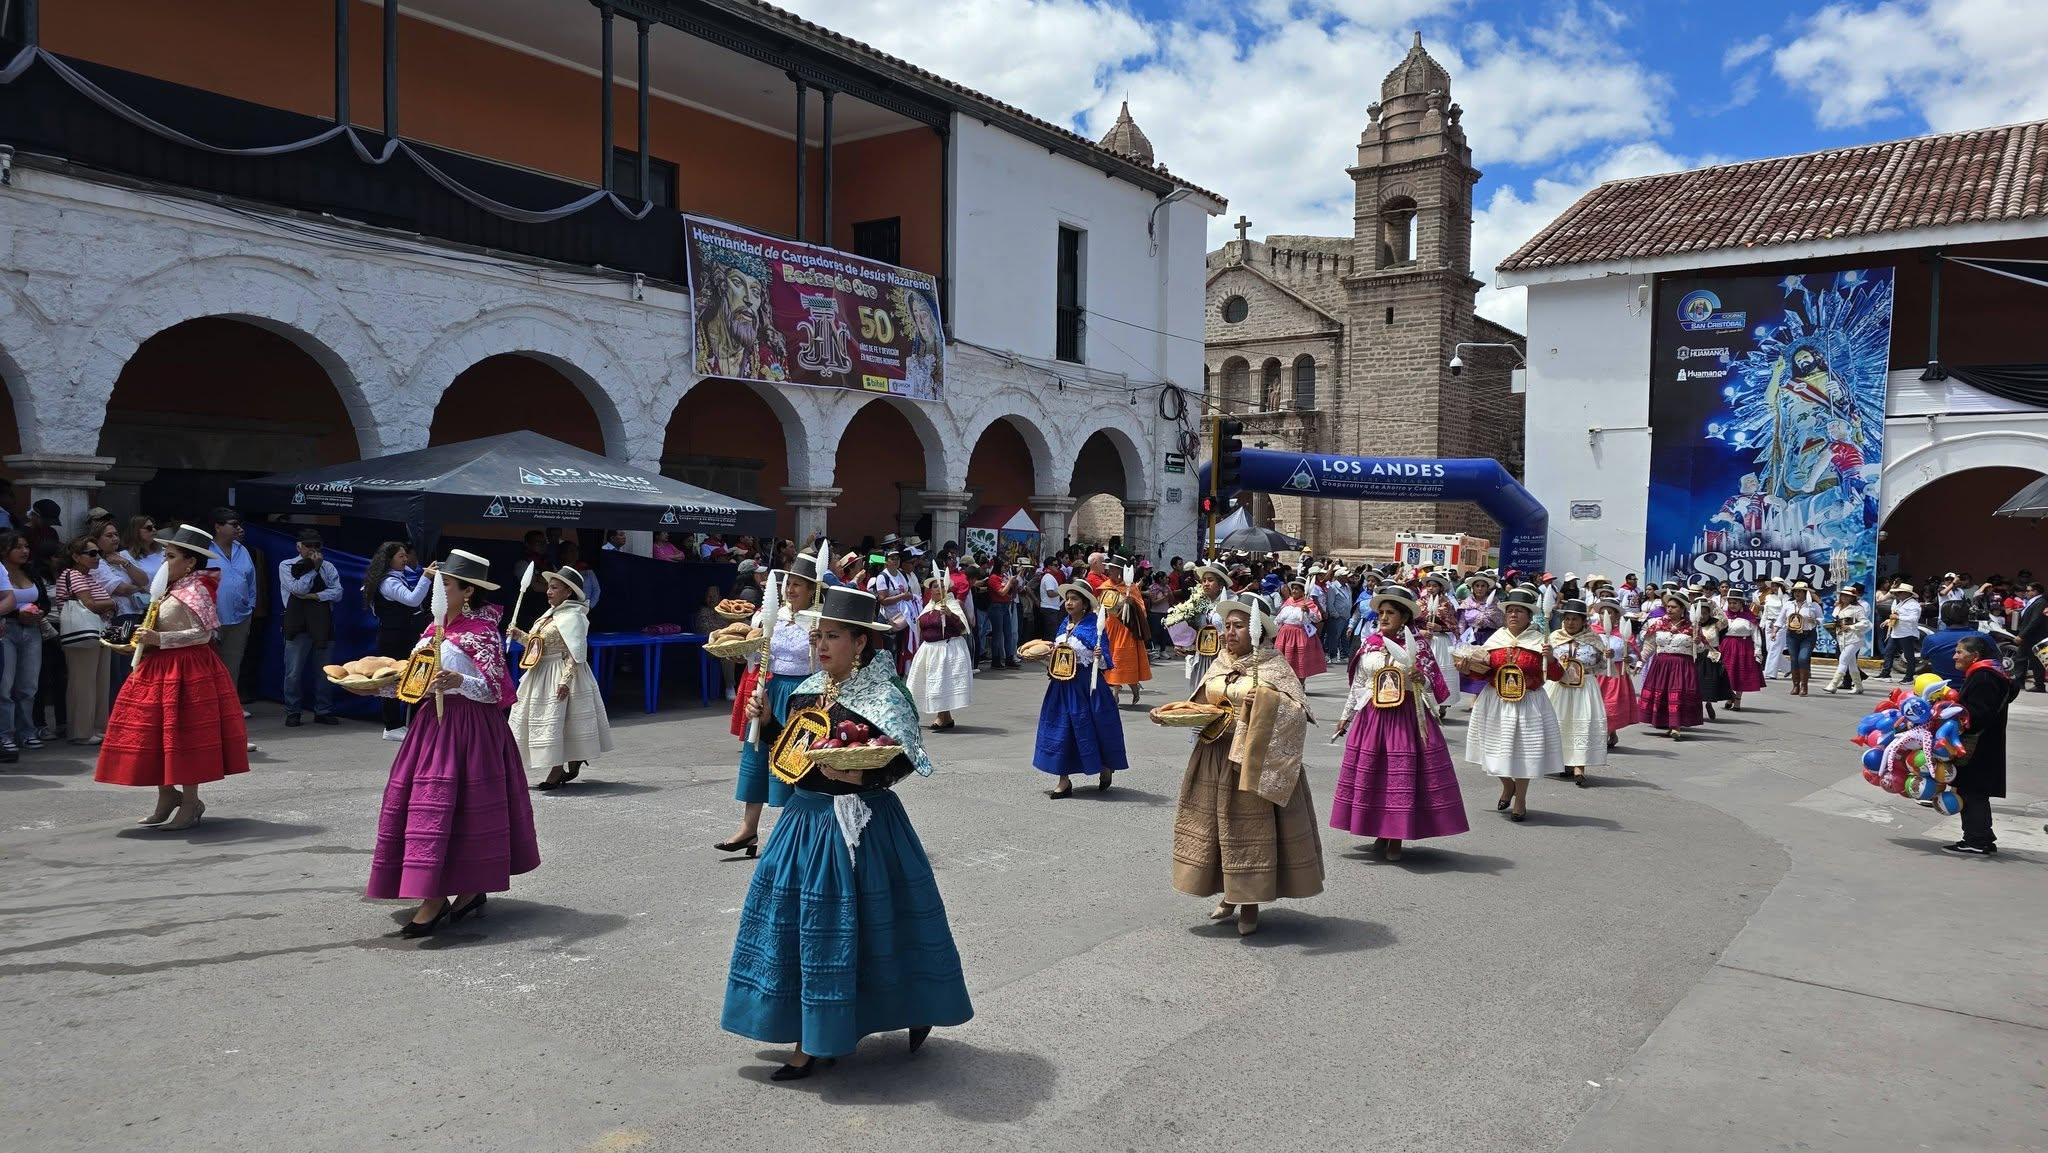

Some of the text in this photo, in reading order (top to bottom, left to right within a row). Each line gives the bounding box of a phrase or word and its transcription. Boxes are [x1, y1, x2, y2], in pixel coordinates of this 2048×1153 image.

[693, 227, 931, 291] Hermandad de Cargadores de Jesús Nazareno
[783, 264, 879, 299] Bodas de Oro
[858, 306, 894, 343] 50
[1690, 350, 1730, 358] HUAMANGA
[1687, 370, 1728, 379] Huamanga
[537, 467, 581, 477] LOS
[588, 470, 651, 485] ANDES
[1322, 459, 1445, 478] LOS ANDES
[1321, 480, 1369, 489] Cooperativa
[509, 495, 535, 504] LOS
[540, 497, 584, 507] ANDES
[679, 504, 738, 516] LOS ANDES
[1687, 550, 1824, 590] Santa
